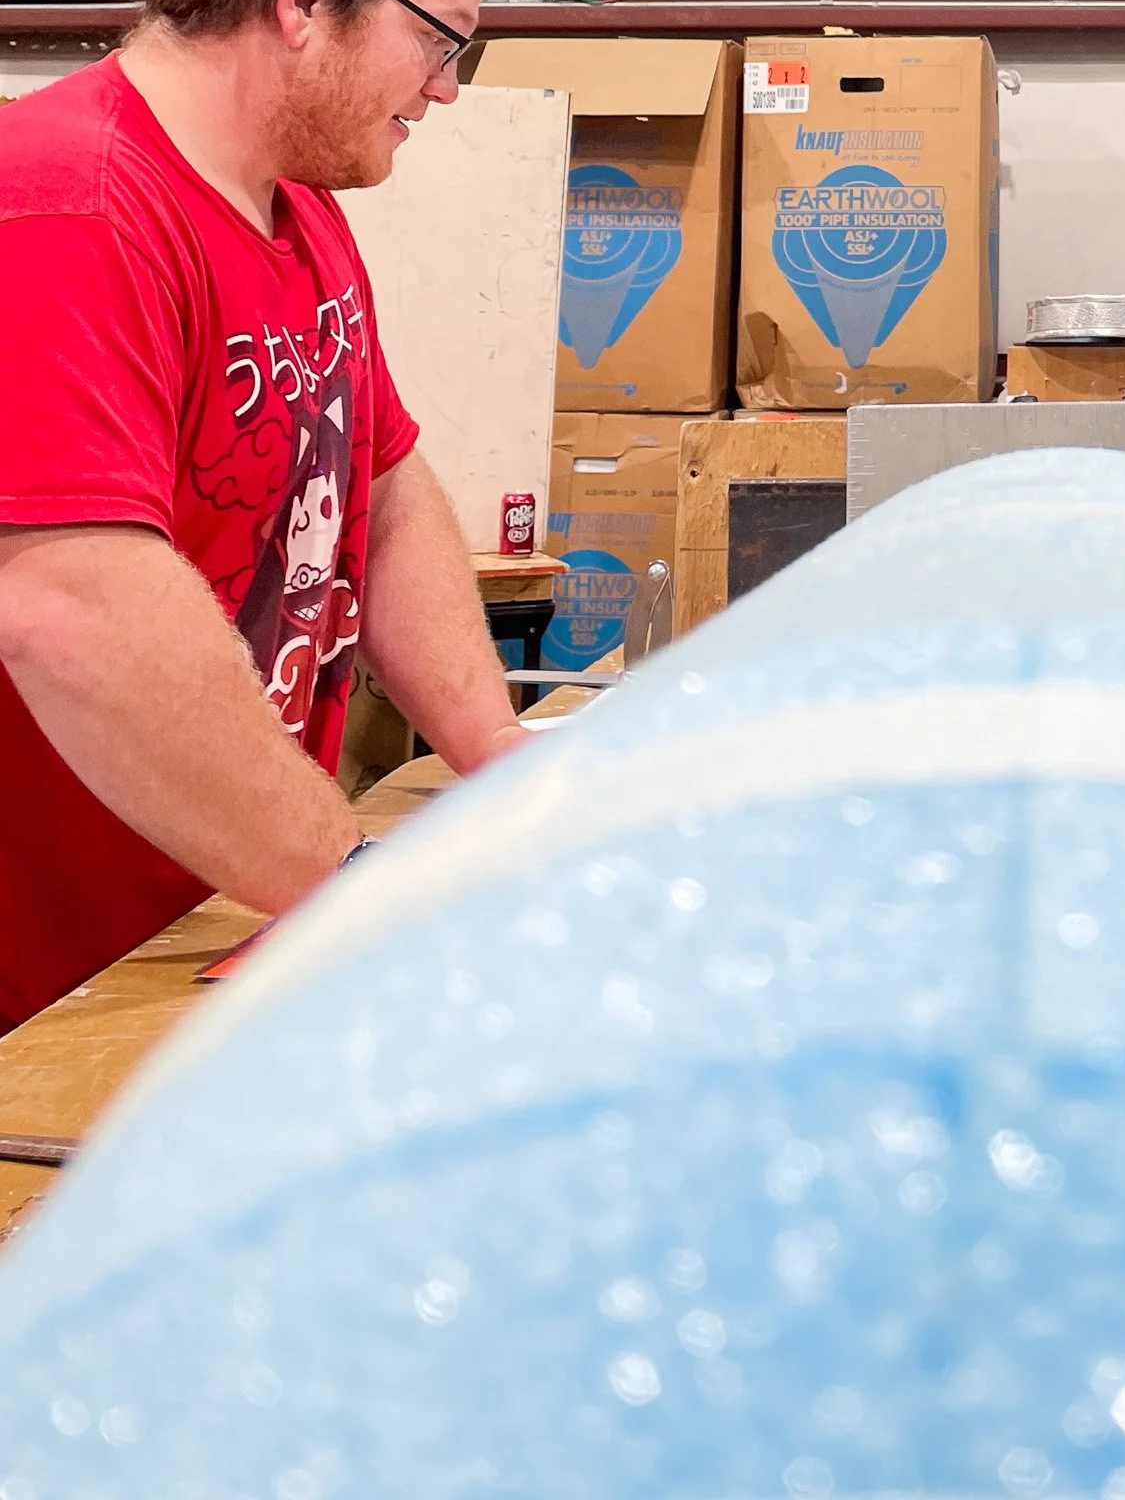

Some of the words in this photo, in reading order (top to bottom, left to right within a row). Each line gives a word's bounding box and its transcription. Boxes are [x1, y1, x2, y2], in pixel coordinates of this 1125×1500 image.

[768, 67, 773, 84] 2
[800, 66, 805, 84] 2
[780, 188, 942, 211] EARTHWOOL
[589, 214, 677, 227] INSULATION
[820, 214, 849, 227] PIPE
[854, 214, 942, 227] INSULATION
